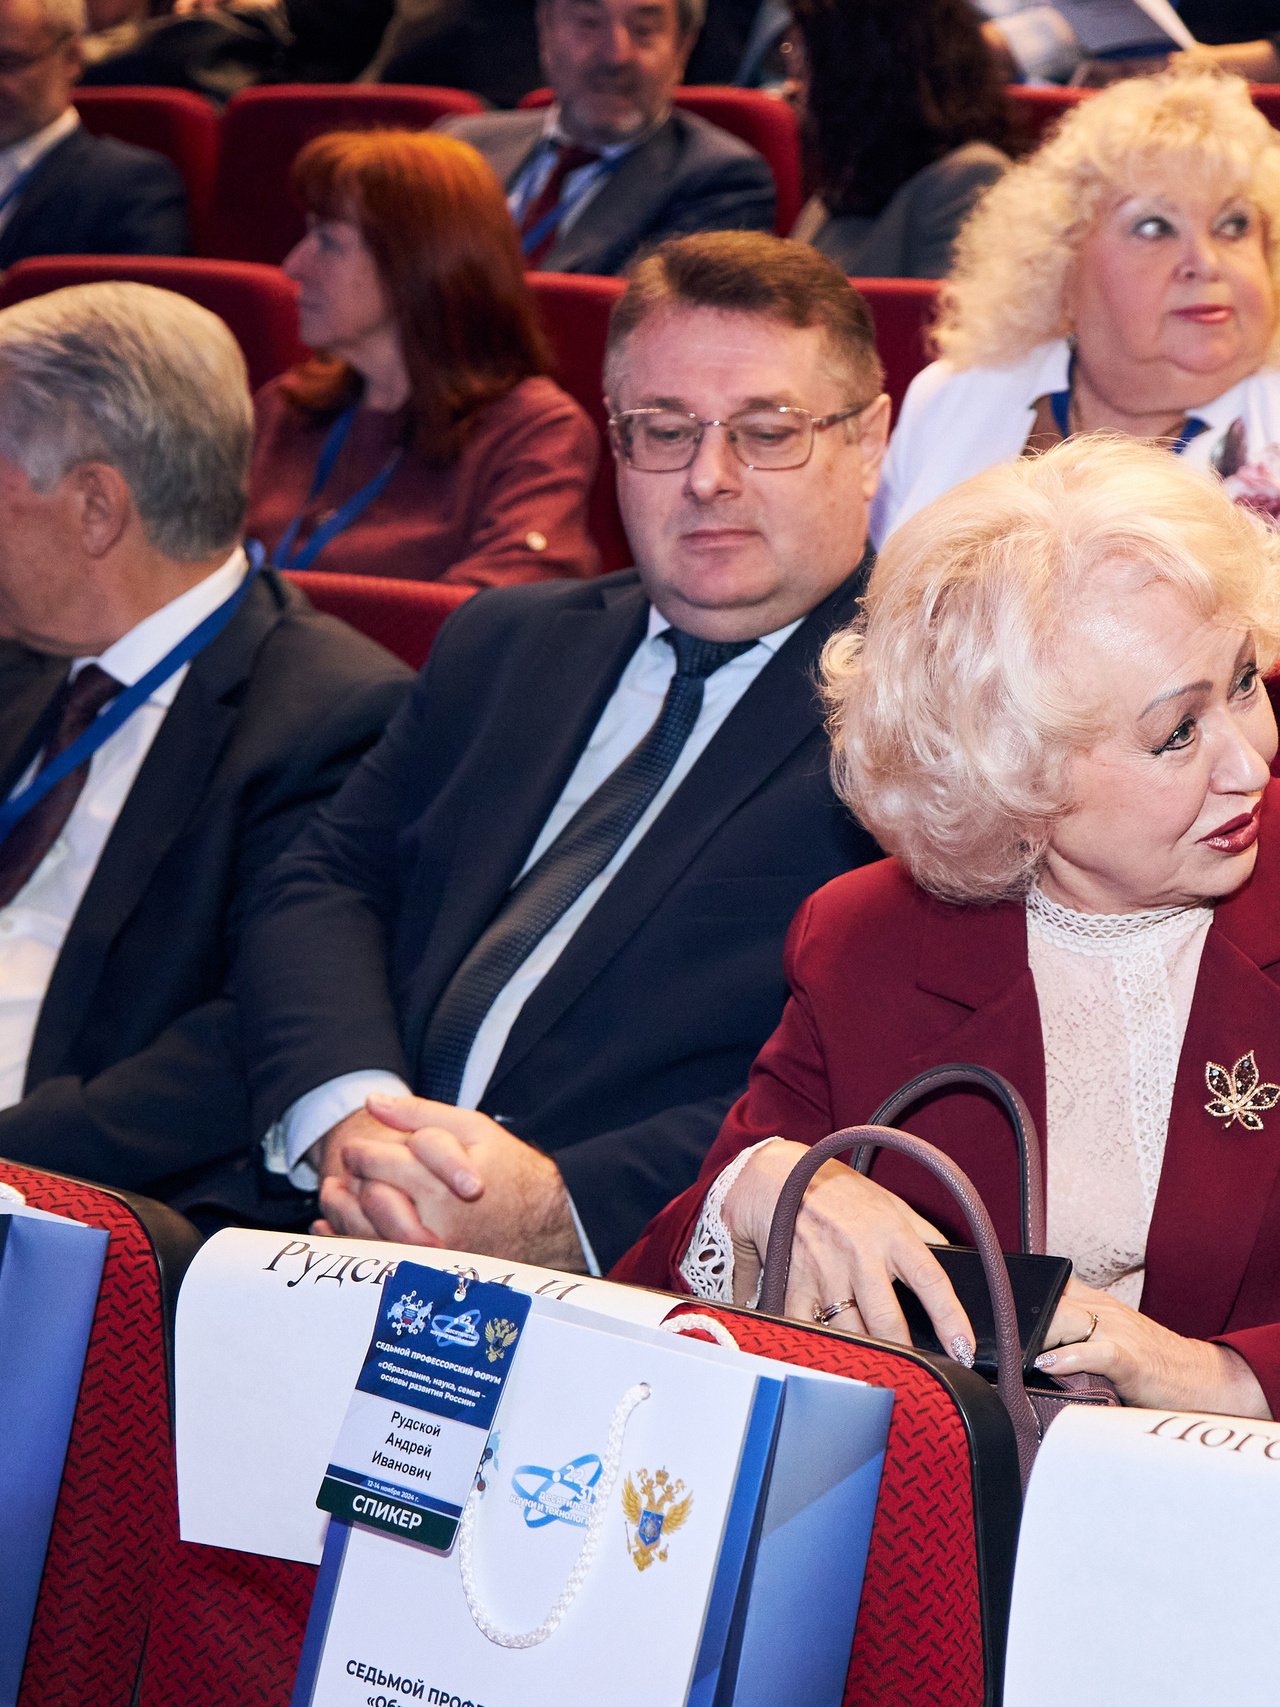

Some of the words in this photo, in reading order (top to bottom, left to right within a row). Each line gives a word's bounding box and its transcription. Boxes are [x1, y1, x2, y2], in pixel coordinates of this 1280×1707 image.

[375, 1341, 411, 1358] СЕДЬМОЙ
[410, 1350, 474, 1377] ПРОФЕССОРСКИЙ
[473, 1369, 502, 1385] ФОРУМ
[380, 1373, 409, 1388] основы
[408, 1382, 443, 1399] развития
[444, 1392, 476, 1408] России»
[457, 1385, 481, 1399] семья
[390, 1411, 441, 1437] Рудской
[384, 1432, 432, 1457] Андрей
[371, 1450, 432, 1481] Иванович
[563, 1464, 585, 1486] 22
[510, 1494, 537, 1511] науки
[575, 1484, 593, 1502] 31
[352, 1494, 423, 1530] СПИКЕР
[346, 1659, 425, 1700] СЕДЬМОЙ
